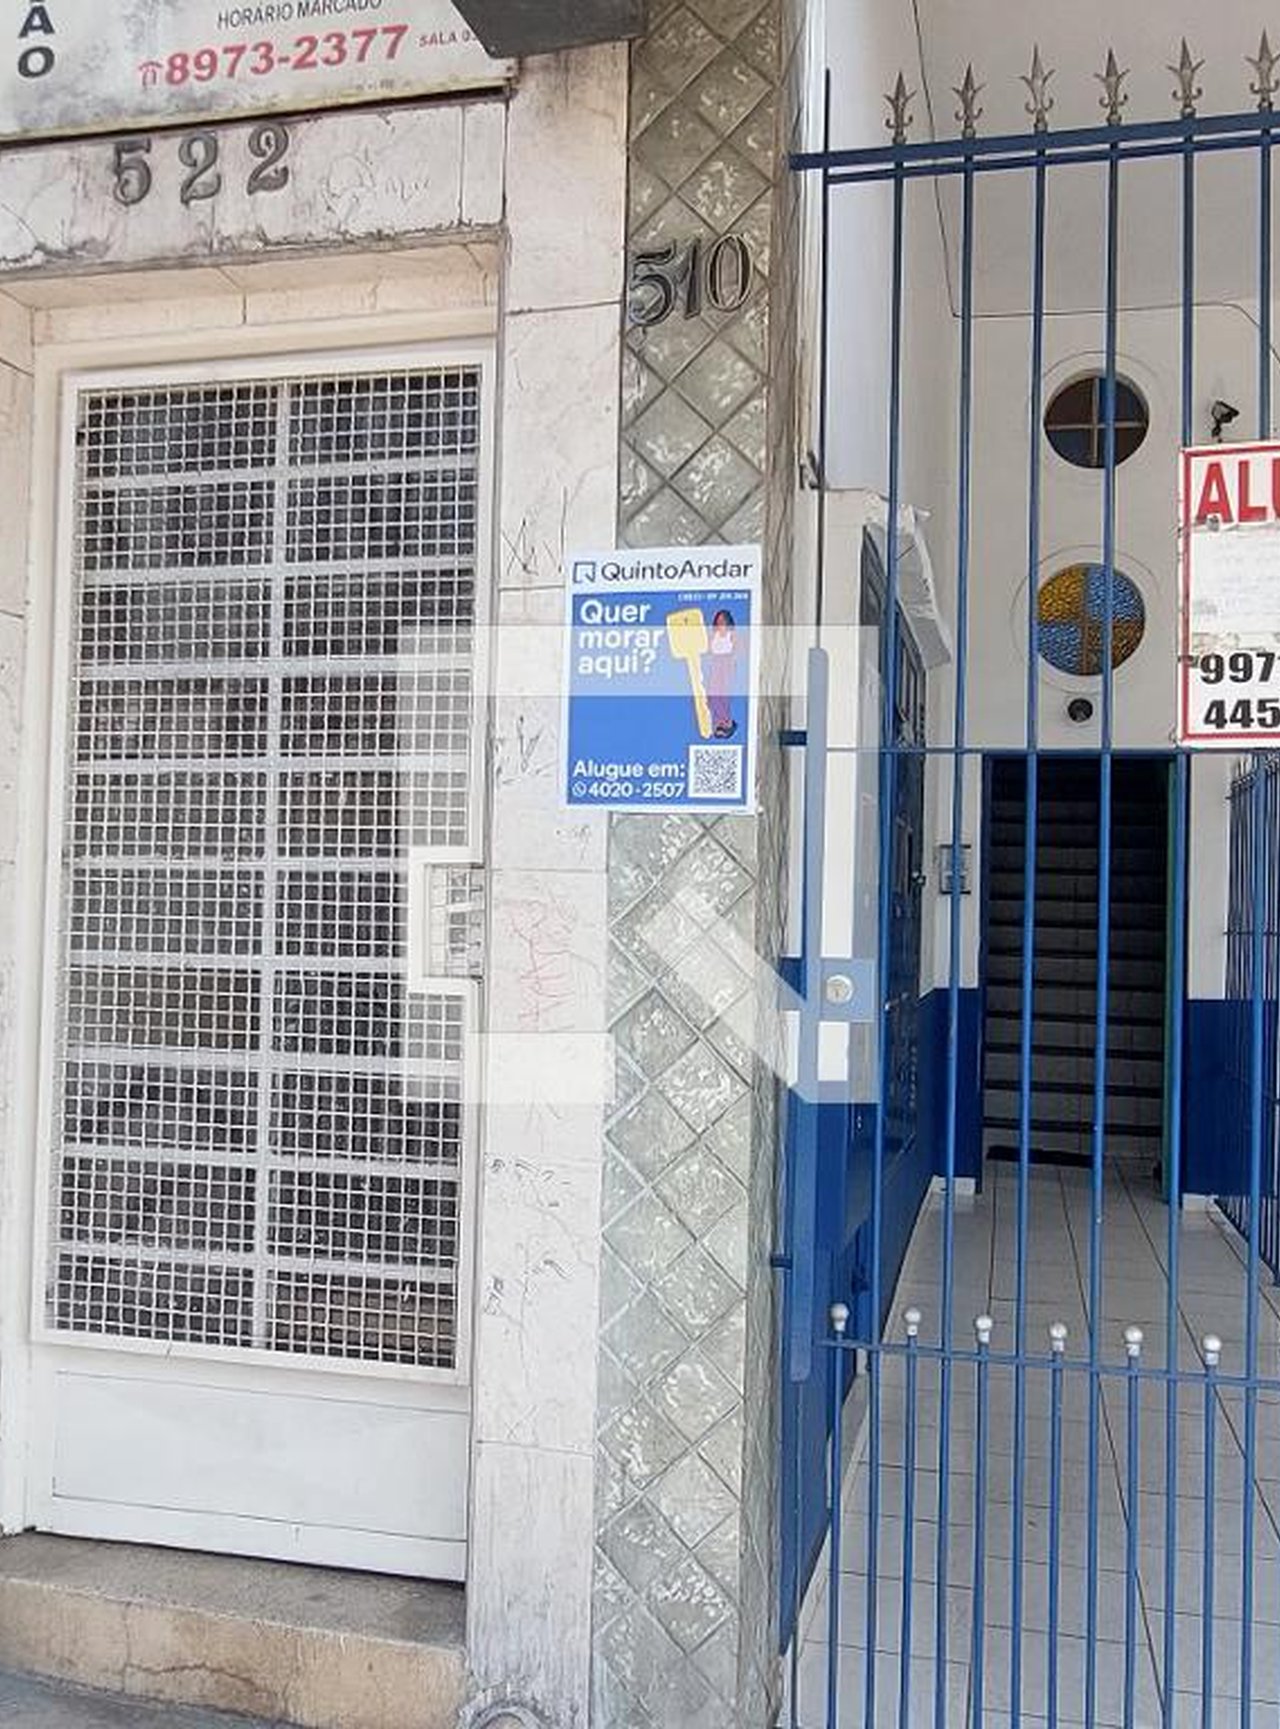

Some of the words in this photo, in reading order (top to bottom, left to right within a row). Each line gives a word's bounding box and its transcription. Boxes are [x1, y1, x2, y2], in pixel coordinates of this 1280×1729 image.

[297, 0, 381, 19] MARCADO
[165, 24, 409, 86] 8973-2377
[419, 32, 458, 47] SALA
[112, 122, 290, 206] 522
[629, 233, 754, 326] 510
[601, 560, 754, 582] QuintoAndar
[580, 600, 652, 625] Quer
[579, 628, 665, 650] morar
[578, 649, 657, 679] aqui?
[573, 760, 644, 780] Alugue
[648, 763, 686, 778] em:
